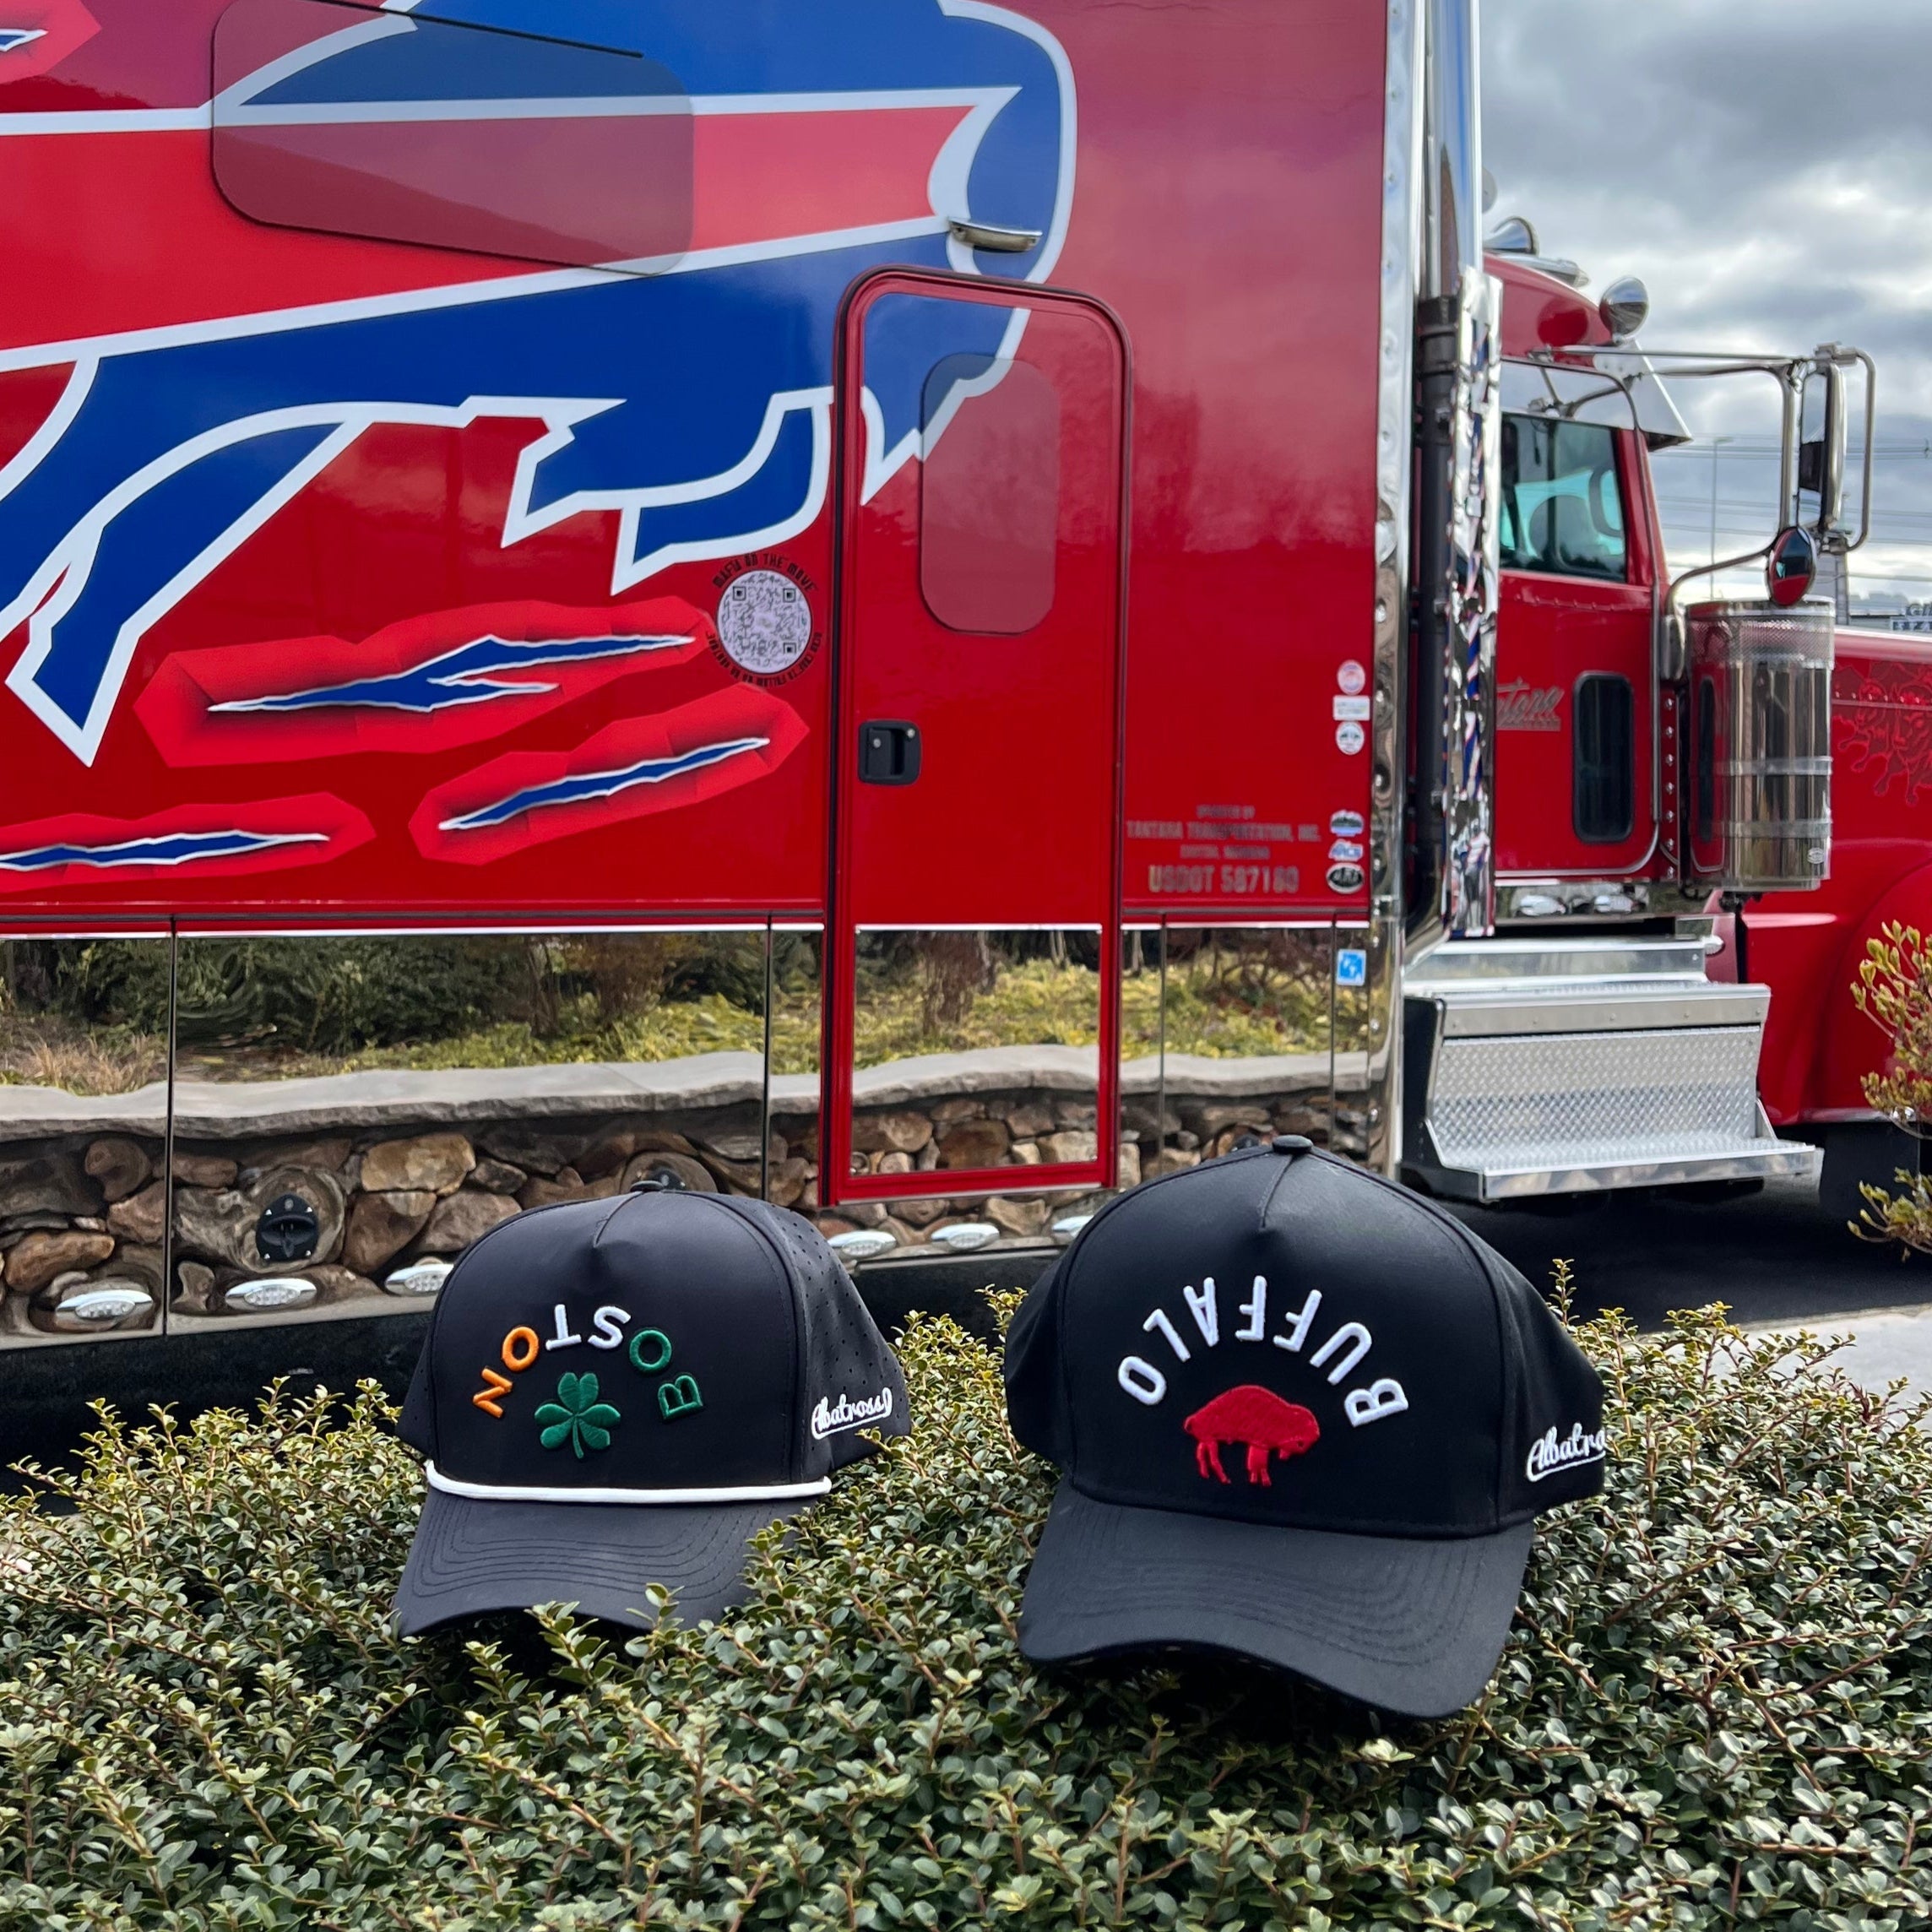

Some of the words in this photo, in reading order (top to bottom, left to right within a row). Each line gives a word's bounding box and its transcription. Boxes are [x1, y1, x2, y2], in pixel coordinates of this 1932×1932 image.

[762, 553, 788, 568] THE
[787, 562, 818, 592] MOVE
[1148, 865, 1215, 893] USDOT
[472, 1304, 703, 1420] BOSTON
[1117, 1275, 1409, 1427] BUFFALO
